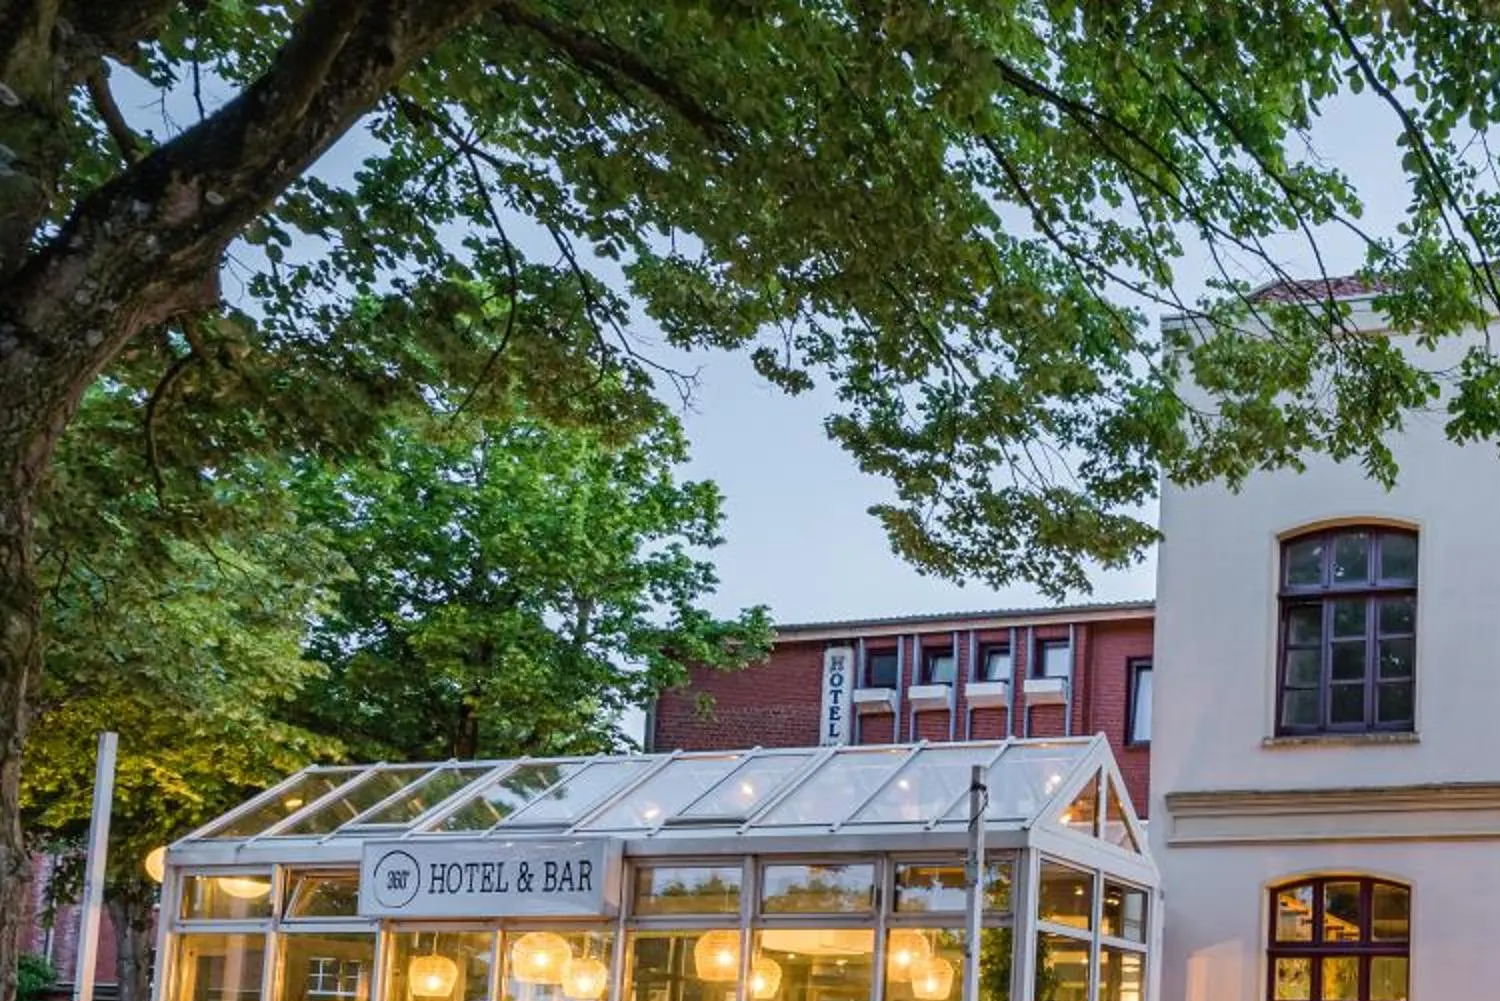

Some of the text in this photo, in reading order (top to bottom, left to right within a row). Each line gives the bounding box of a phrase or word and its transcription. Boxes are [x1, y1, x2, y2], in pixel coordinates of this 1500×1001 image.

[829, 655, 845, 737] HOTEL
[428, 859, 593, 895] HOTEL & BAR
